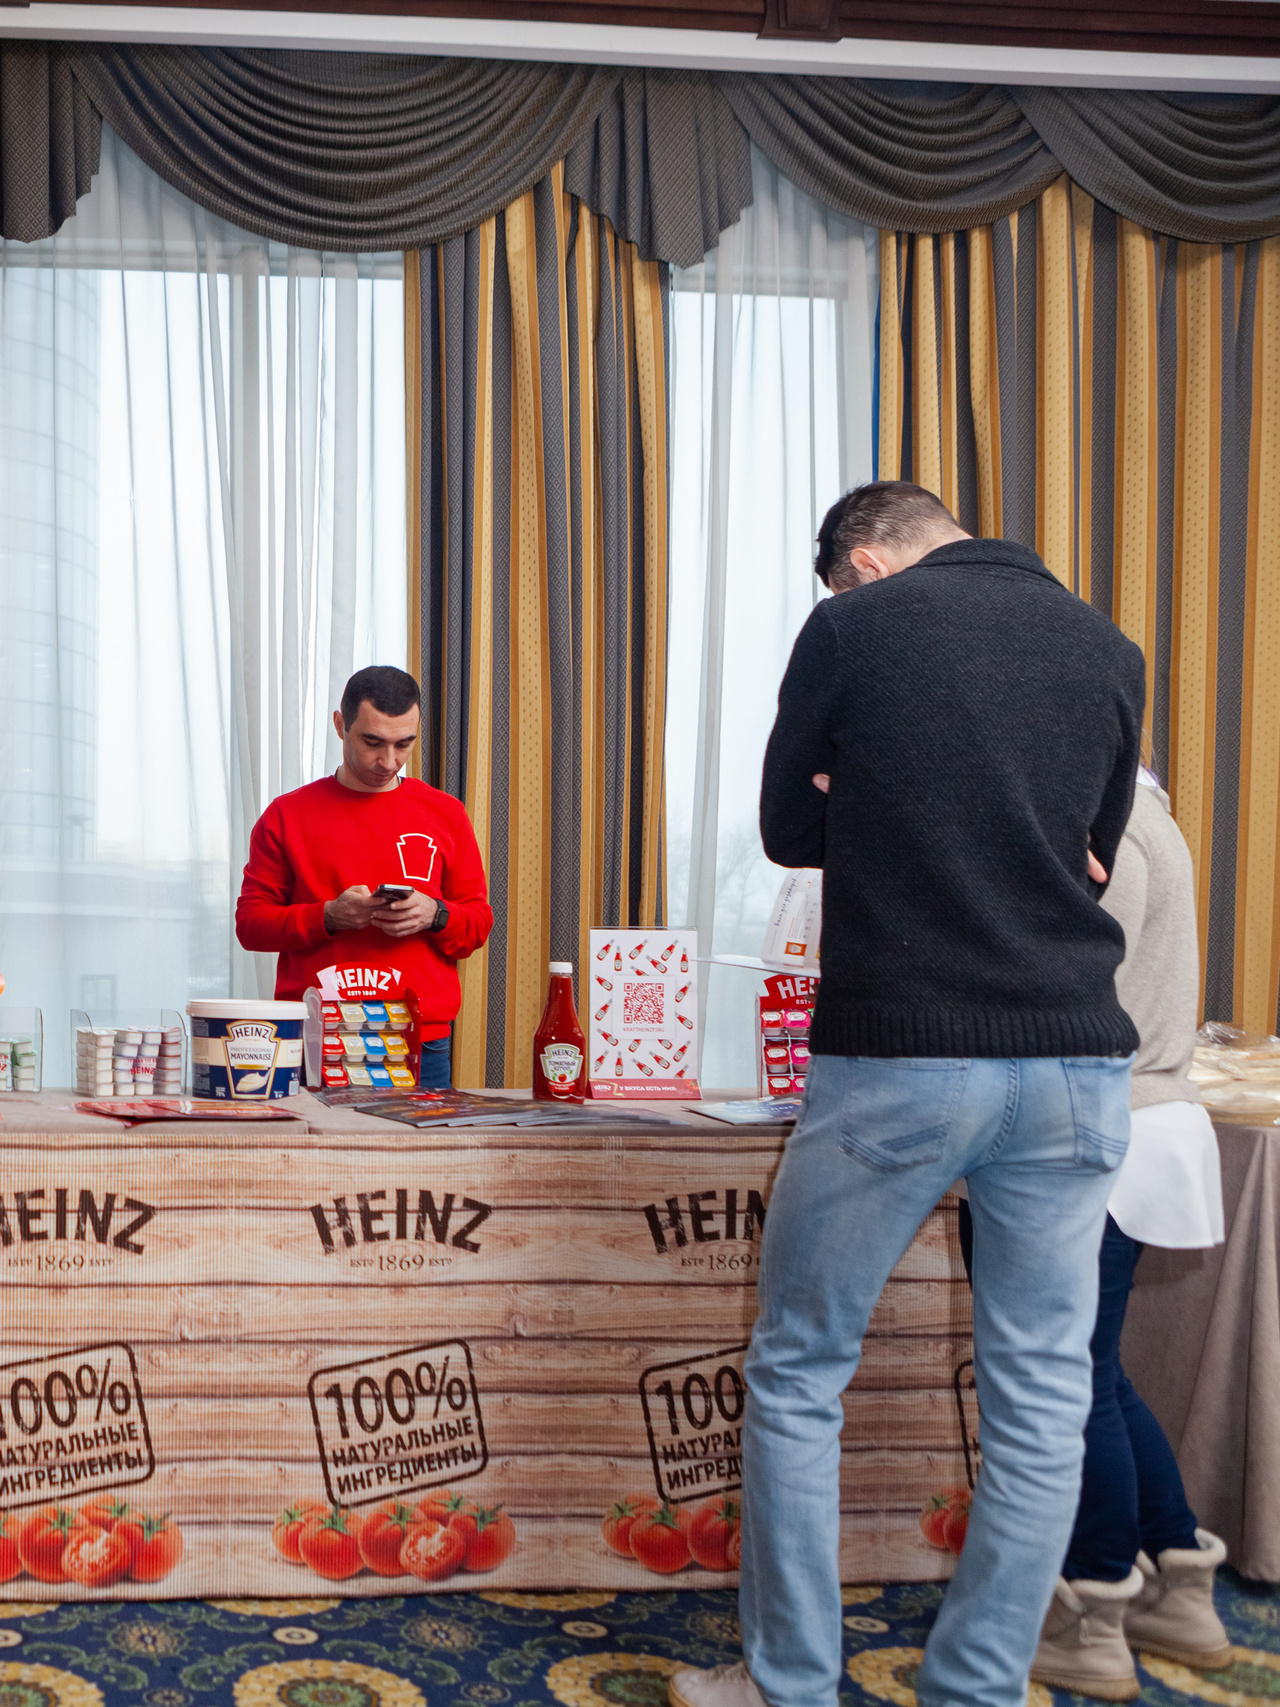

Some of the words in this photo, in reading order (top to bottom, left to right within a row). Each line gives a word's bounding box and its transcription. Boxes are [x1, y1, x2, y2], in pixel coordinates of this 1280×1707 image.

[330, 968, 392, 991] HEINZ
[235, 1026, 269, 1039] HEINZ
[551, 1049, 574, 1057] HEINZ
[130, 1067, 156, 1075] HEINZ
[310, 1189, 492, 1256] HEINZ
[643, 1189, 766, 1254] HEIN
[37, 1255, 85, 1272] 1869
[379, 1254, 424, 1271] 1869
[708, 1254, 752, 1271] 1869
[325, 1356, 467, 1438] 100%
[655, 1366, 747, 1435] 100
[332, 1416, 474, 1468] НАТУРАЛЬНЫЕ
[337, 1442, 477, 1494] ИНГРЕДИЕНТЫ
[666, 1454, 742, 1490] ИНГРЕД
